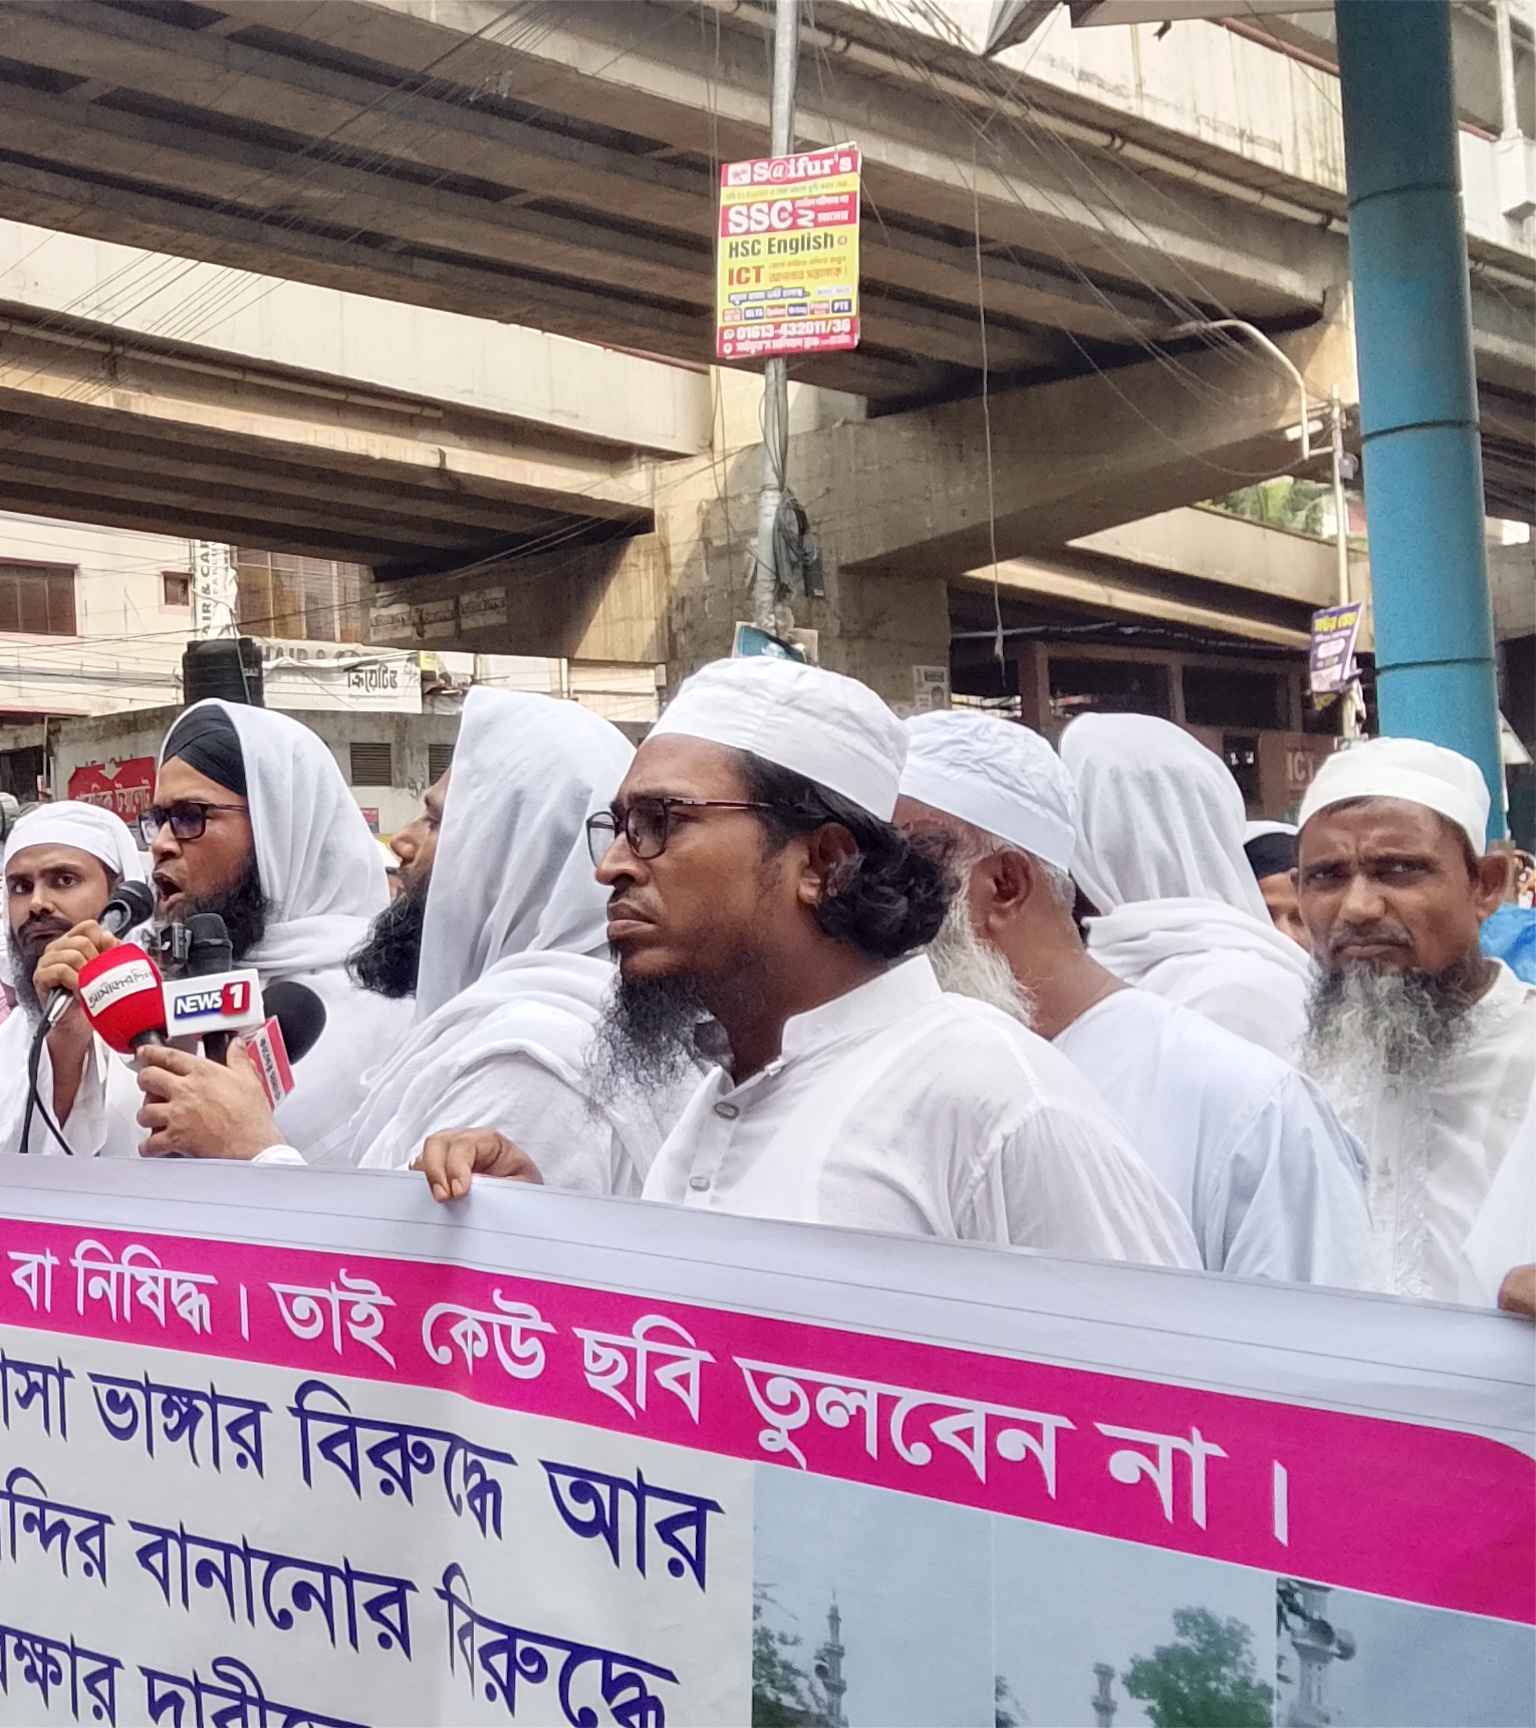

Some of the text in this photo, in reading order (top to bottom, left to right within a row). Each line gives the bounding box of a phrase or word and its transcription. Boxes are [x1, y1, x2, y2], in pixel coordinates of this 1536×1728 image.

[752, 154, 853, 184] S@ifur's
[728, 200, 793, 234] SSC
[728, 232, 834, 258] HSC English
[728, 265, 765, 286] ICT
[176, 983, 244, 1016] NEWS 1
[9, 1247, 60, 1314] বা
[71, 1239, 218, 1335] নিষিদ্ধ
[268, 1268, 396, 1370] তাই
[422, 1288, 559, 1380] কেউ
[573, 1314, 717, 1425] ছবি
[733, 1355, 1078, 1500] তুলবেন
[1096, 1421, 1231, 1531] না
[88, 1369, 273, 1480] ভাঙ্গার
[286, 1378, 519, 1542] বিরুদ্ধে
[537, 1458, 728, 1595] আর
[128, 1519, 421, 1663] বানানোর
[433, 1562, 682, 1728] বিরুদ্ধে
